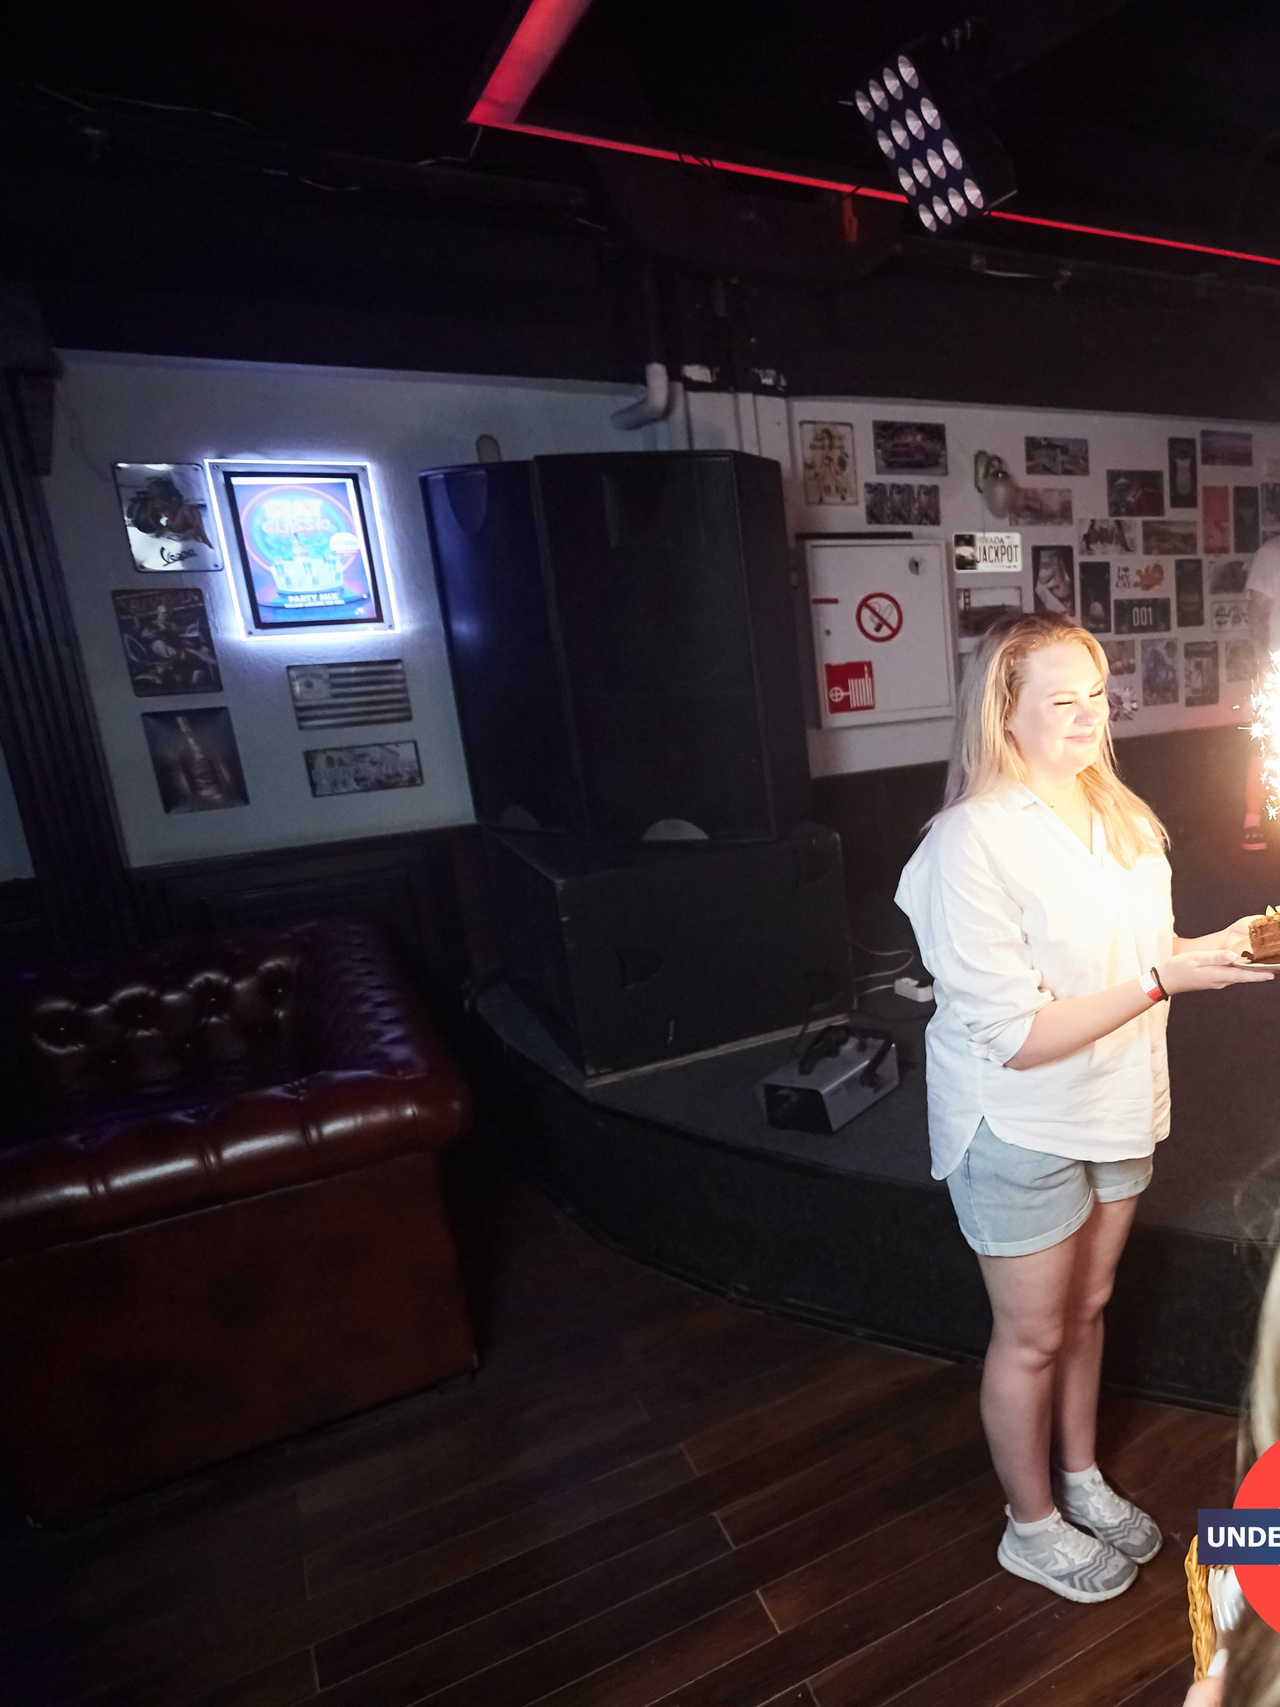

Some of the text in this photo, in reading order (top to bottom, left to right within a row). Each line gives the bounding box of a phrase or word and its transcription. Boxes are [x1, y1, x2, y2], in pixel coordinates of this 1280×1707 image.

[976, 545, 1018, 563] JACKPOT
[288, 592, 338, 604] PARTY MIX
[1132, 607, 1153, 626] 001
